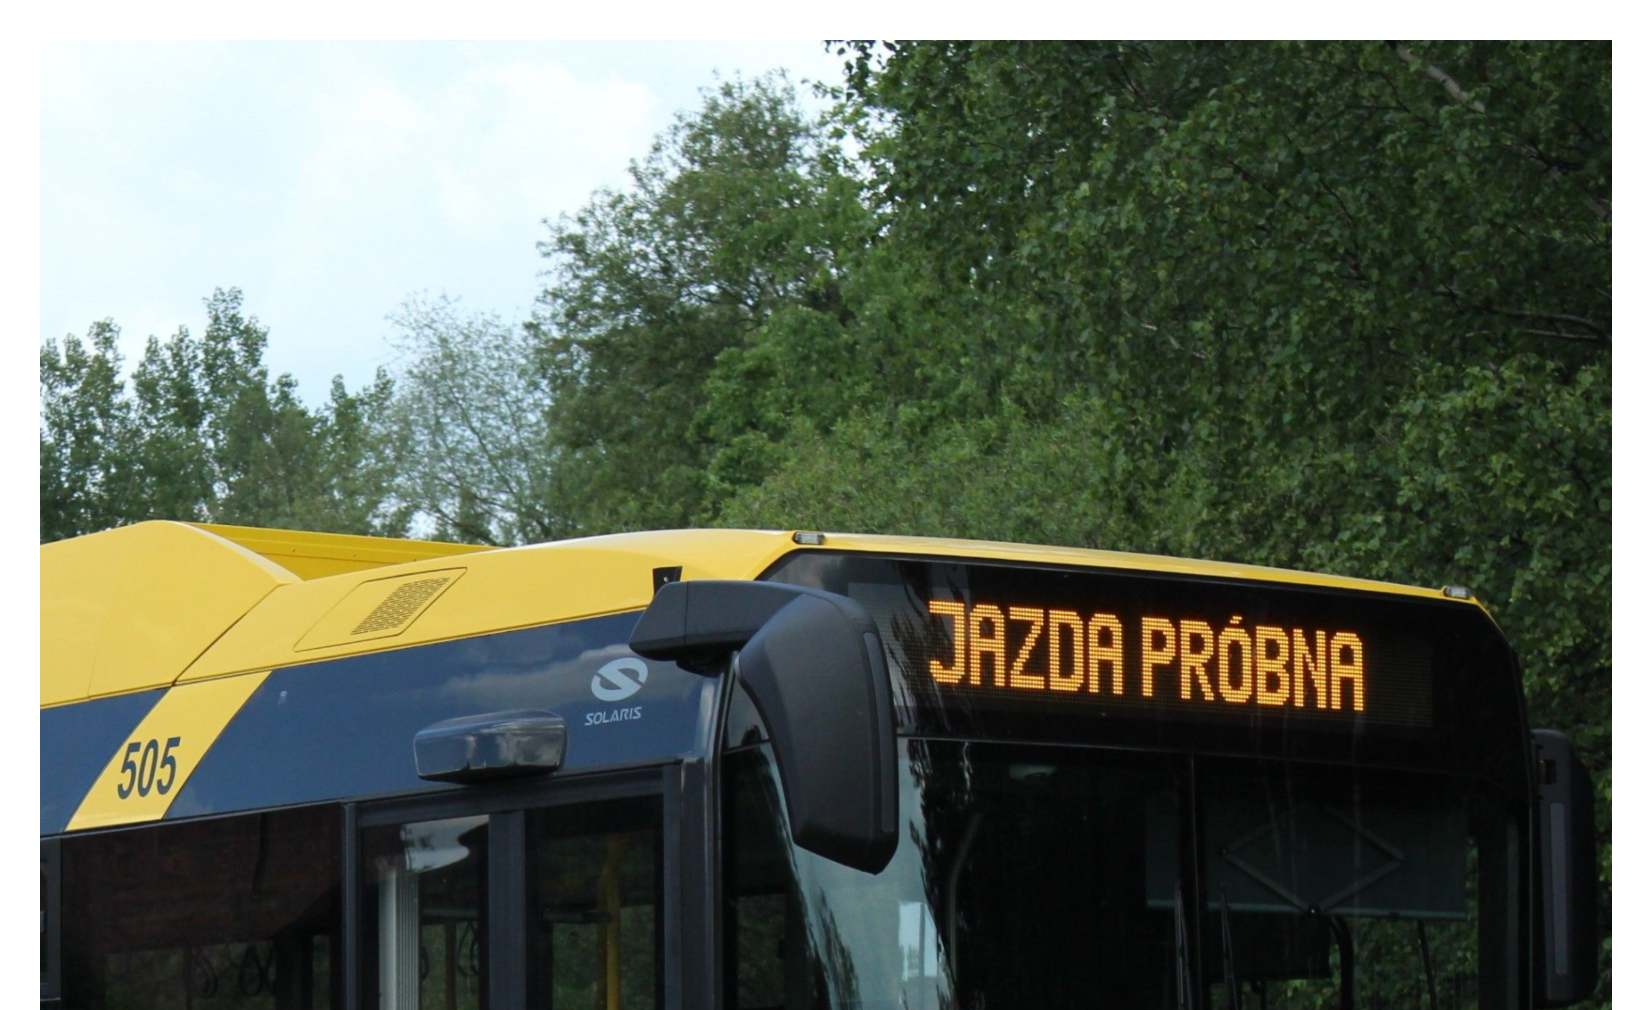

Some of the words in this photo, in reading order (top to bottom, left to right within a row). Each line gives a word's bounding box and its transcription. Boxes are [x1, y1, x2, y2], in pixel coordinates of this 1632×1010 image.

[928, 600, 1124, 696] JAZDA
[1141, 615, 1365, 712] PRÓBNA
[584, 706, 643, 726] SOLARIS
[117, 736, 181, 800] 505
